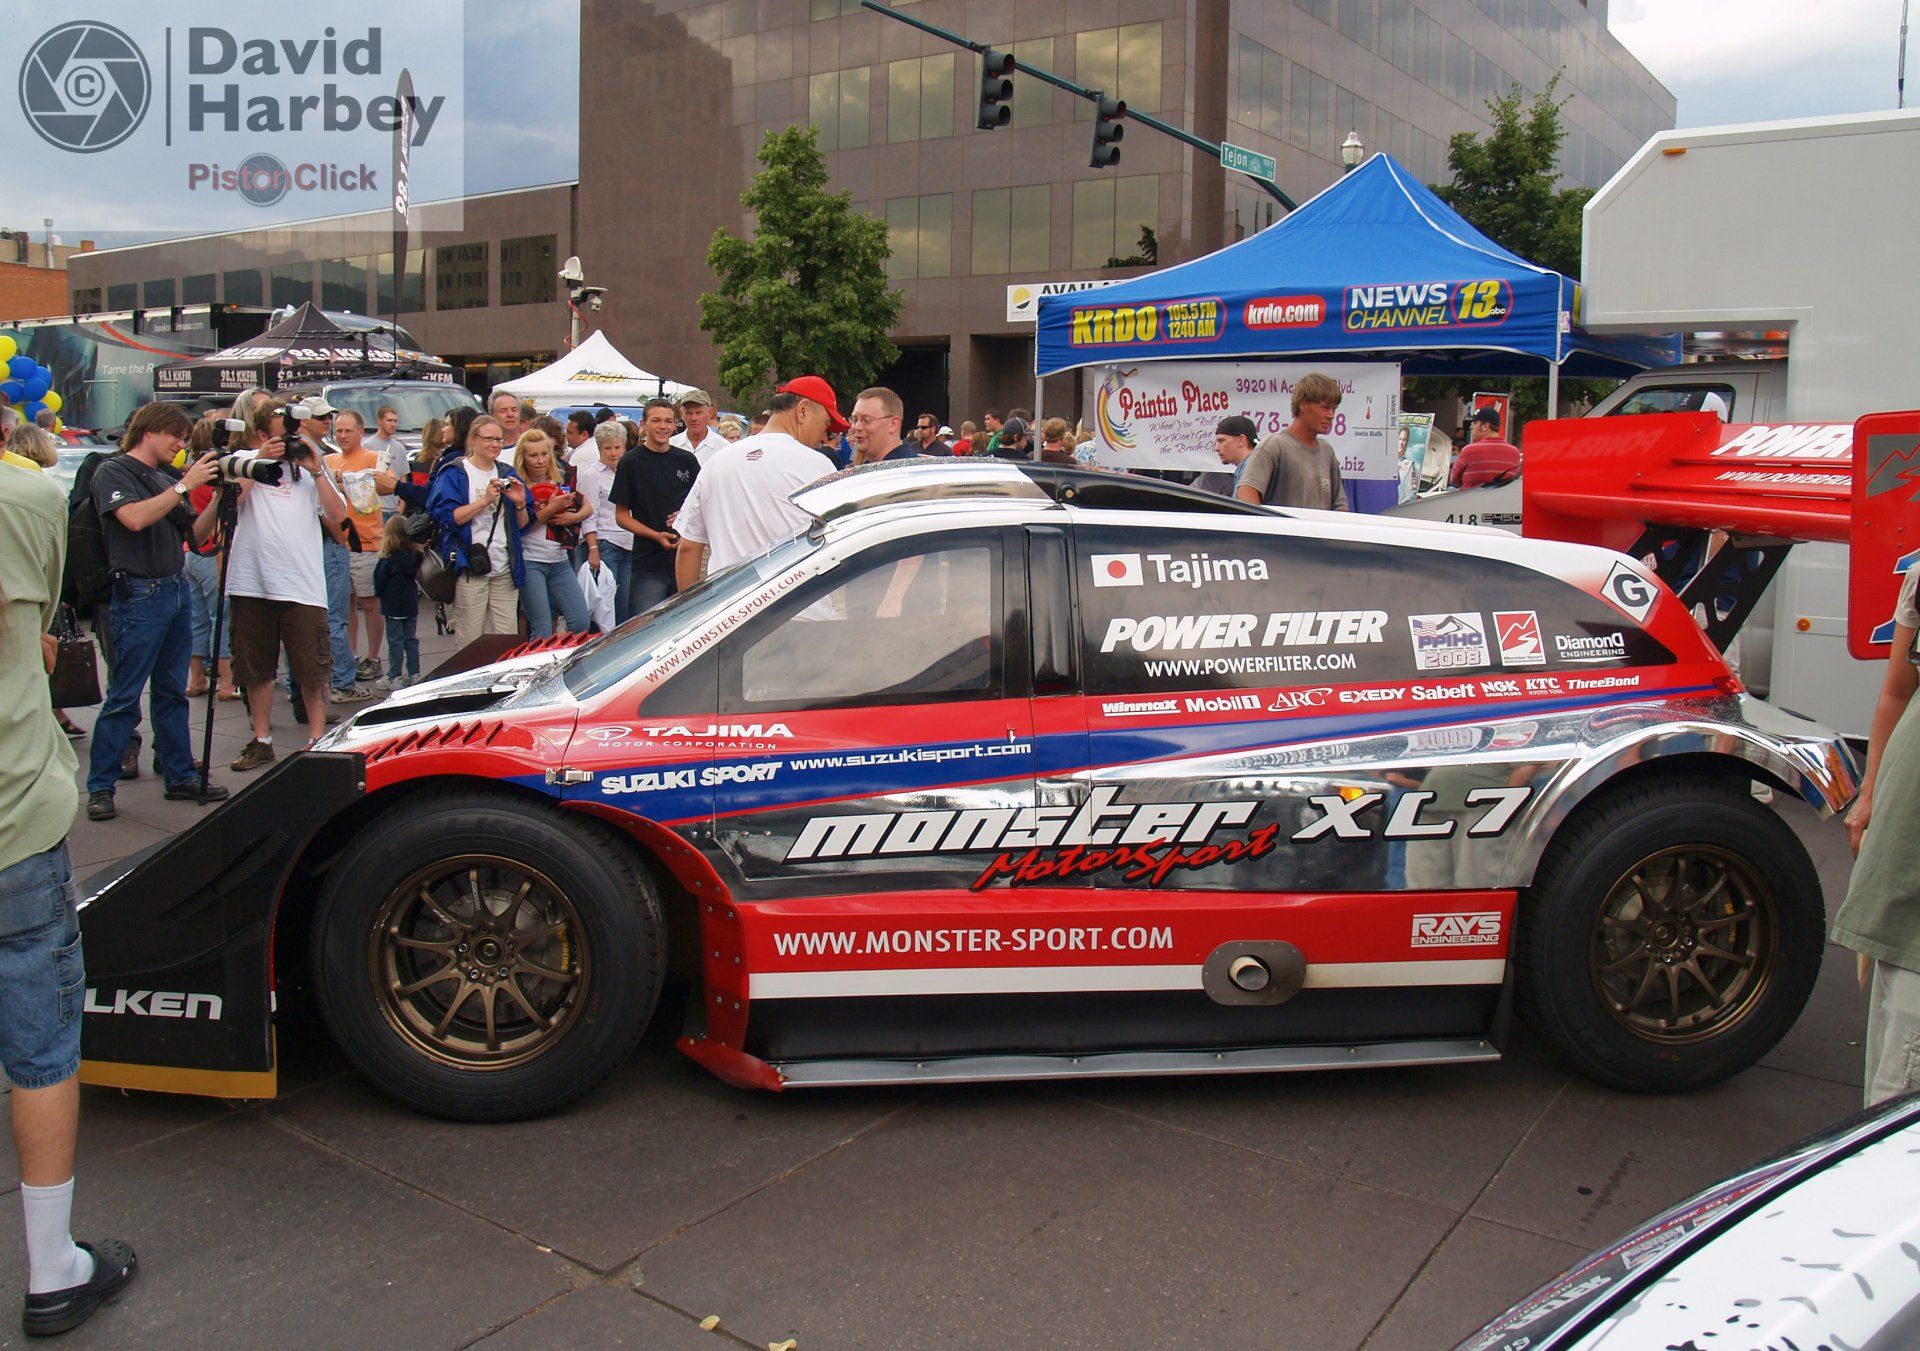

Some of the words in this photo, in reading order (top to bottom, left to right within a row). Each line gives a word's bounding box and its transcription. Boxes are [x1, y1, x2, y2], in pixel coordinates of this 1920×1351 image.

[1224, 146, 1248, 167] Tejon
[1351, 284, 1448, 308] NEWS
[1458, 281, 1500, 319] 13
[1490, 306, 1506, 316] abc
[1168, 304, 1198, 321] 105.5
[1200, 302, 1217, 318] FM
[1248, 303, 1319, 325] krdo.com
[1347, 306, 1449, 329] CHANNEL
[1073, 306, 1157, 344] KRDO
[1168, 322, 1196, 339] 1240
[1197, 319, 1215, 337] AM
[129, 364, 145, 374] the
[158, 370, 172, 382] 98.1
[221, 370, 236, 382] 98.1
[236, 370, 258, 383] KKFM
[1236, 378, 1266, 394] 3920
[1269, 378, 1277, 394] N
[1119, 387, 1178, 421] Paintin
[1181, 380, 1229, 415] Place
[1149, 422, 1174, 431] When
[1176, 421, 1192, 432] You
[1160, 444, 1172, 454] the
[1147, 553, 1269, 589] Tajima
[1613, 573, 1650, 607] G
[645, 569, 807, 684] WWW.MONSTER-SPORT.COM
[1100, 614, 1258, 653] POWER
[1261, 610, 1389, 647] FILTER
[1425, 650, 1481, 668] 2008
[1560, 648, 1625, 658] ENGINEERING
[1144, 653, 1357, 677] WWW.POWERFILTER.COM
[1411, 684, 1476, 701] Sabelt
[1480, 680, 1520, 693] NGK
[1525, 678, 1560, 690] KTC
[1567, 675, 1640, 691] ThreeBond
[1274, 690, 1328, 709] ARC
[1339, 687, 1406, 704] EXEDY
[1102, 700, 1178, 714] Winmax
[643, 724, 795, 738] TAJIMA
[662, 741, 777, 750] CORPORATION
[601, 769, 696, 795] SUZUKI
[699, 762, 784, 787] SPORT
[790, 743, 1032, 771] www.suzukisport.com
[784, 784, 1262, 863] monster
[1289, 786, 1535, 842] XL7
[1411, 915, 1502, 937] RAYS
[773, 925, 1175, 956] WWW.MONSTER-SPORT.COM
[1411, 934, 1500, 944] ENGINEERING
